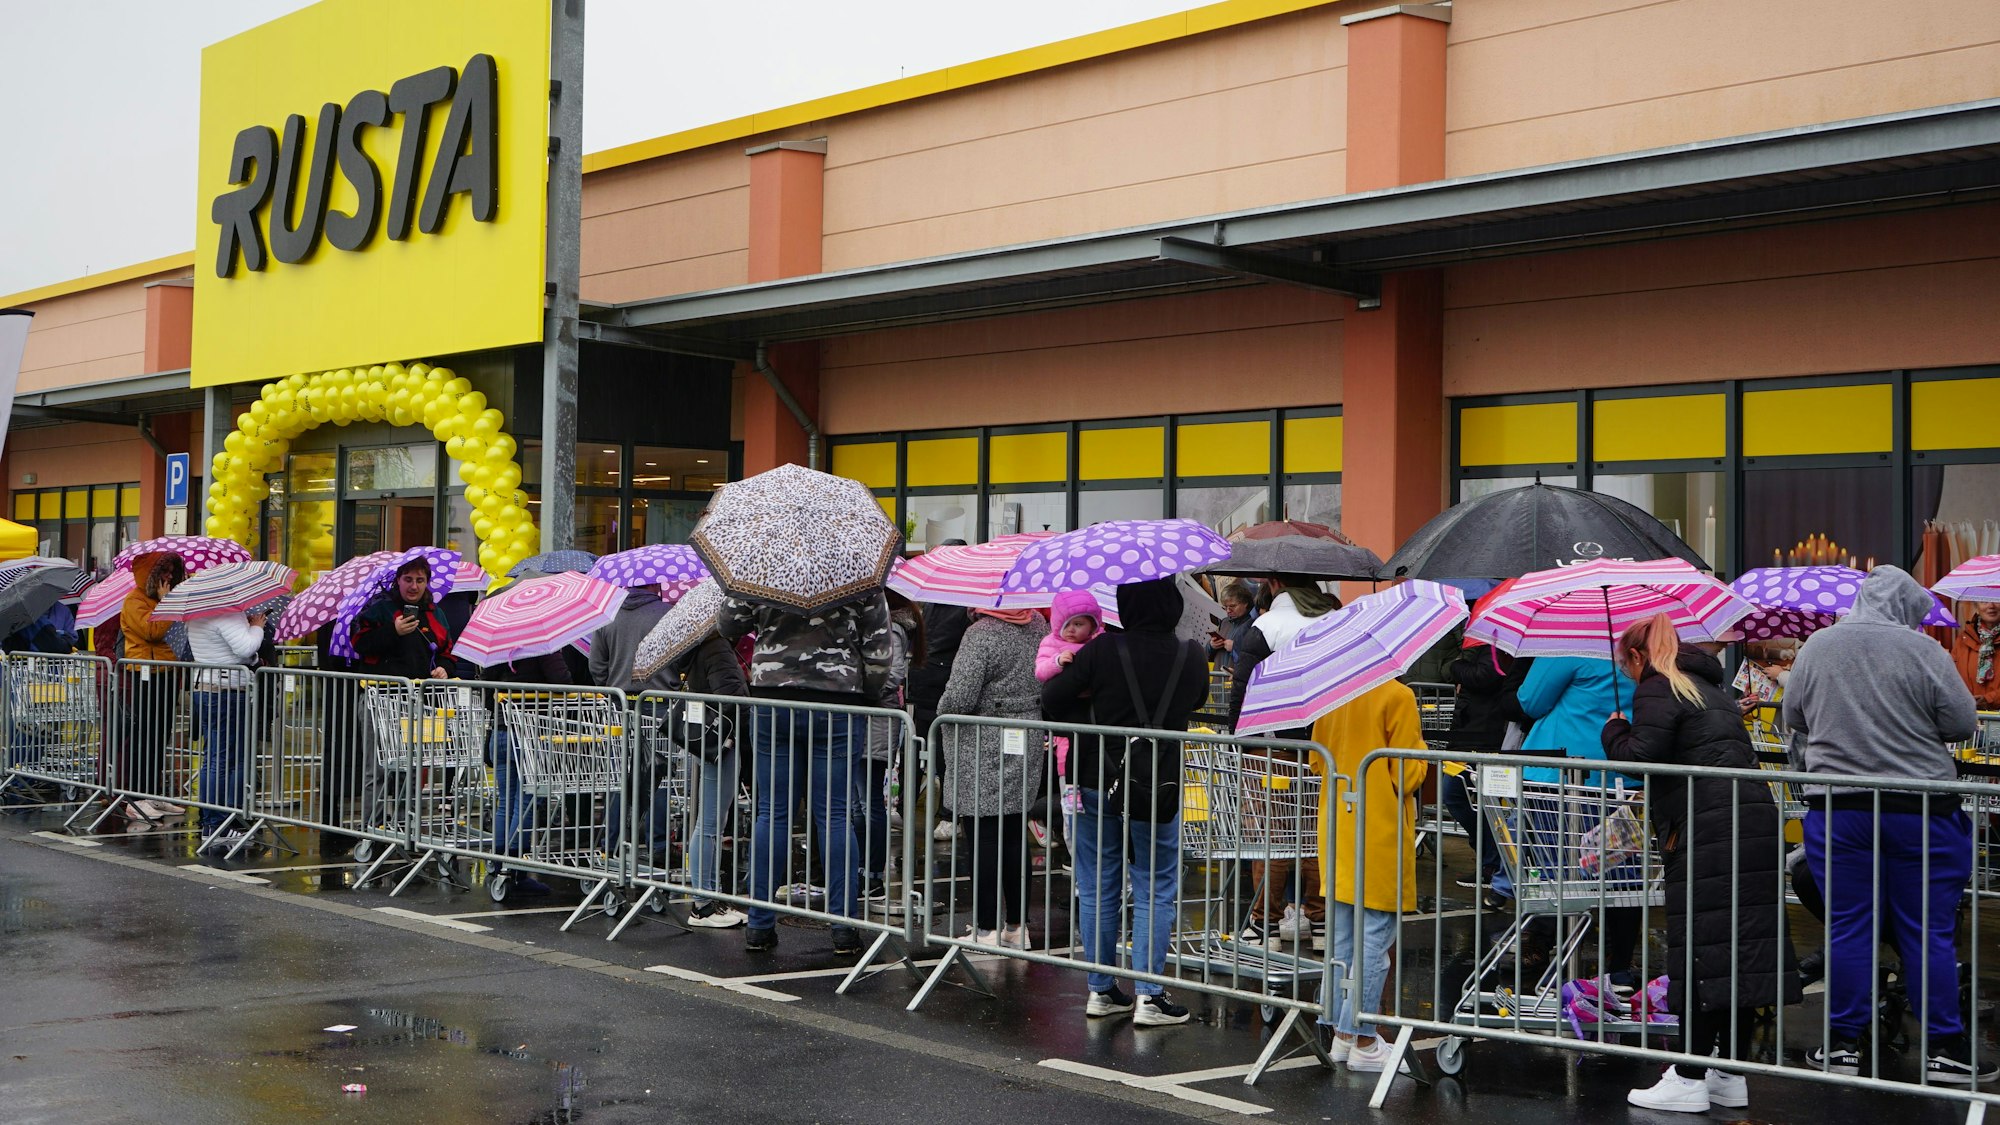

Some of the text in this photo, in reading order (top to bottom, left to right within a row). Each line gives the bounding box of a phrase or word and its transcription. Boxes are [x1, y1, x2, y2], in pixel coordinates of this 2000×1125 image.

[211, 52, 498, 279] RUSTA
[170, 460, 184, 500] P
[1842, 1056, 1858, 1064] NIKE
